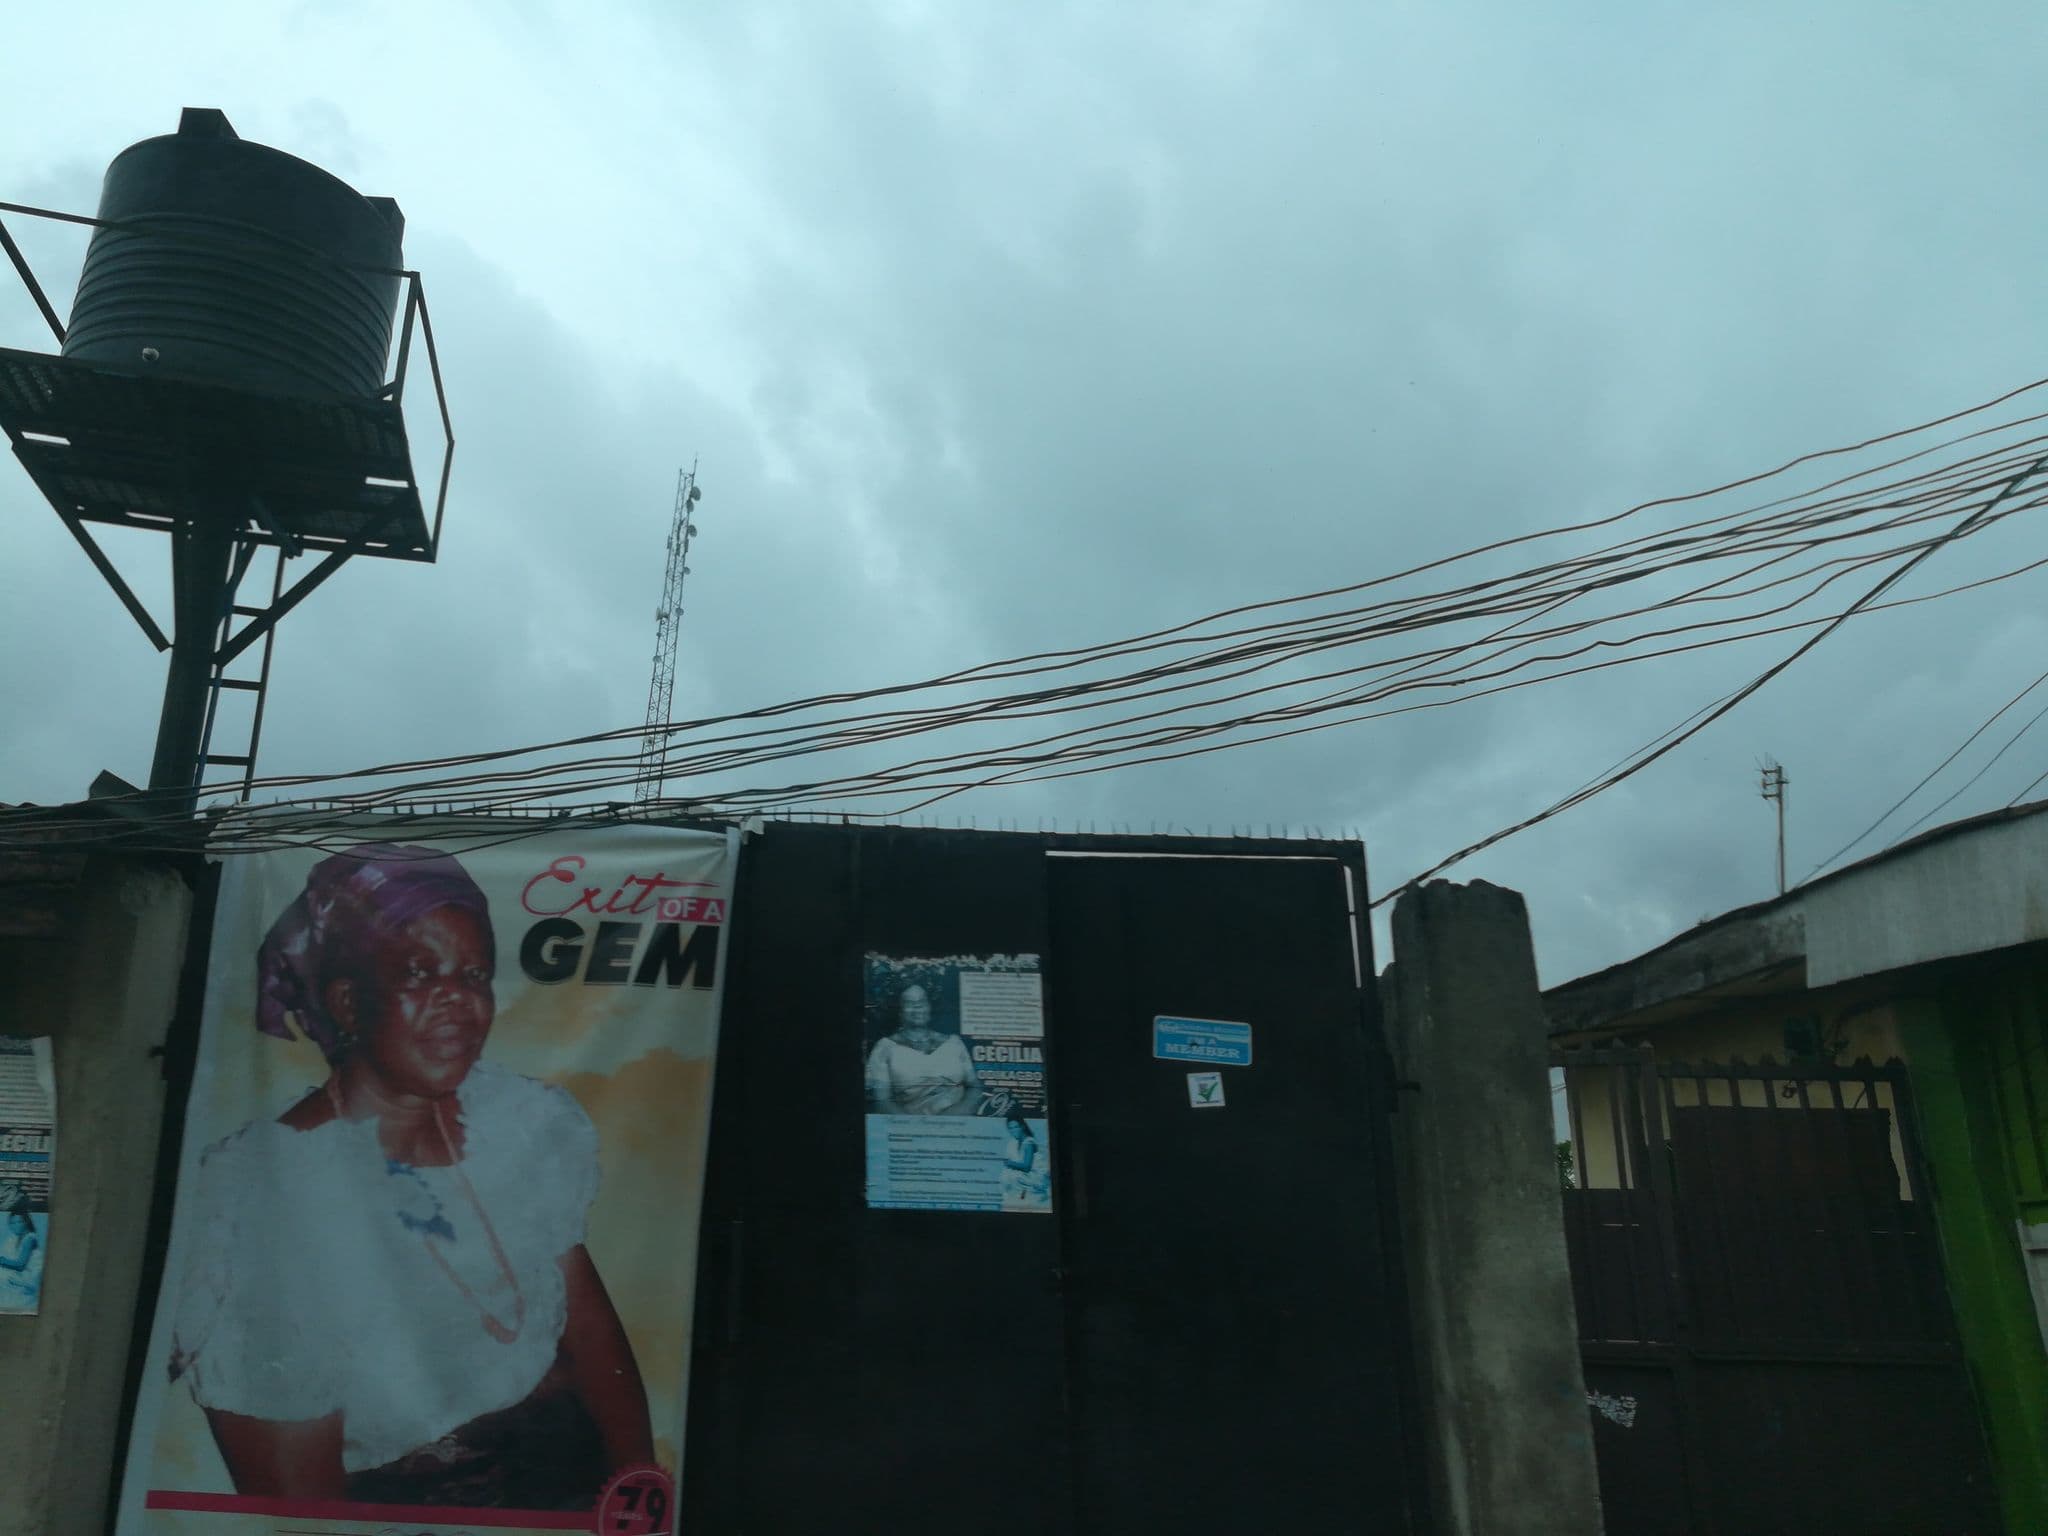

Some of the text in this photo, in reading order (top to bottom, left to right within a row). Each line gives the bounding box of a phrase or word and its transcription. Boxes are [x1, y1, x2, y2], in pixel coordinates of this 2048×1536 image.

[520, 855, 721, 915] Exit
[662, 900, 723, 920] OF A
[519, 917, 721, 991] GEM
[973, 1045, 1043, 1063] CECILIA
[617, 1487, 666, 1531] 79
